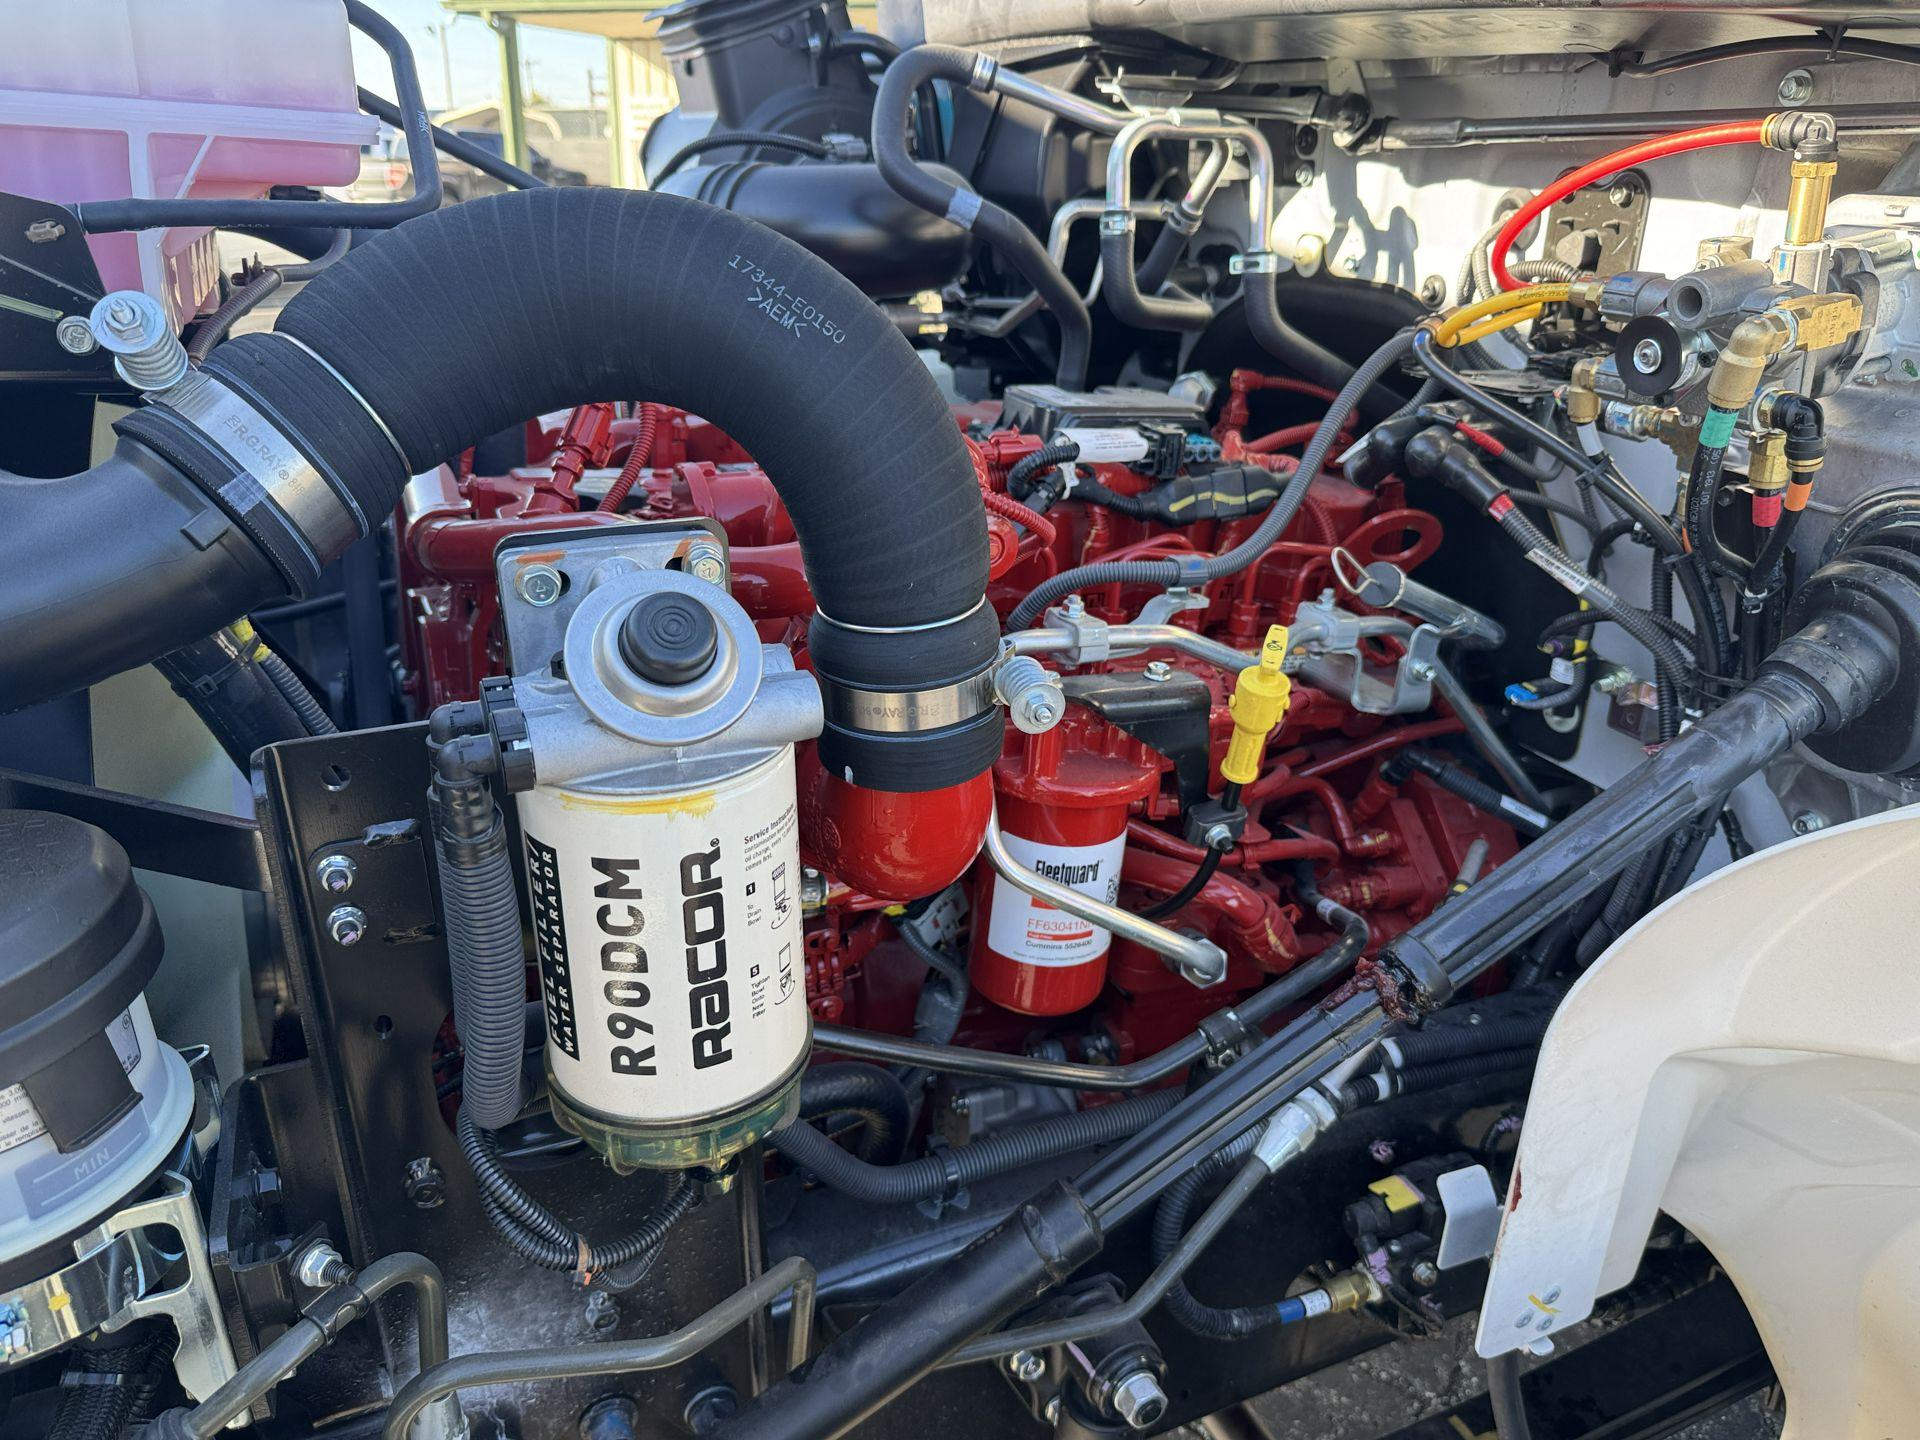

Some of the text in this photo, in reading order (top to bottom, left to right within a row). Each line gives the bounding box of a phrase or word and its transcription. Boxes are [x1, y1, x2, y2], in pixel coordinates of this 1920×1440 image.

[728, 254, 846, 344] 17344-E0150
[744, 827, 769, 845] Service
[1035, 860, 1101, 886] Fleetguard
[747, 908, 762, 919] Drain
[747, 916, 762, 927] Bowl
[544, 850, 575, 1053] WATER SEPARATOR
[1025, 940, 1063, 950] Cummins
[591, 857, 657, 1076] R90DCM
[544, 977, 562, 1045] FUEL
[752, 1002, 764, 1012] New
[73, 1148, 109, 1180] MIN
